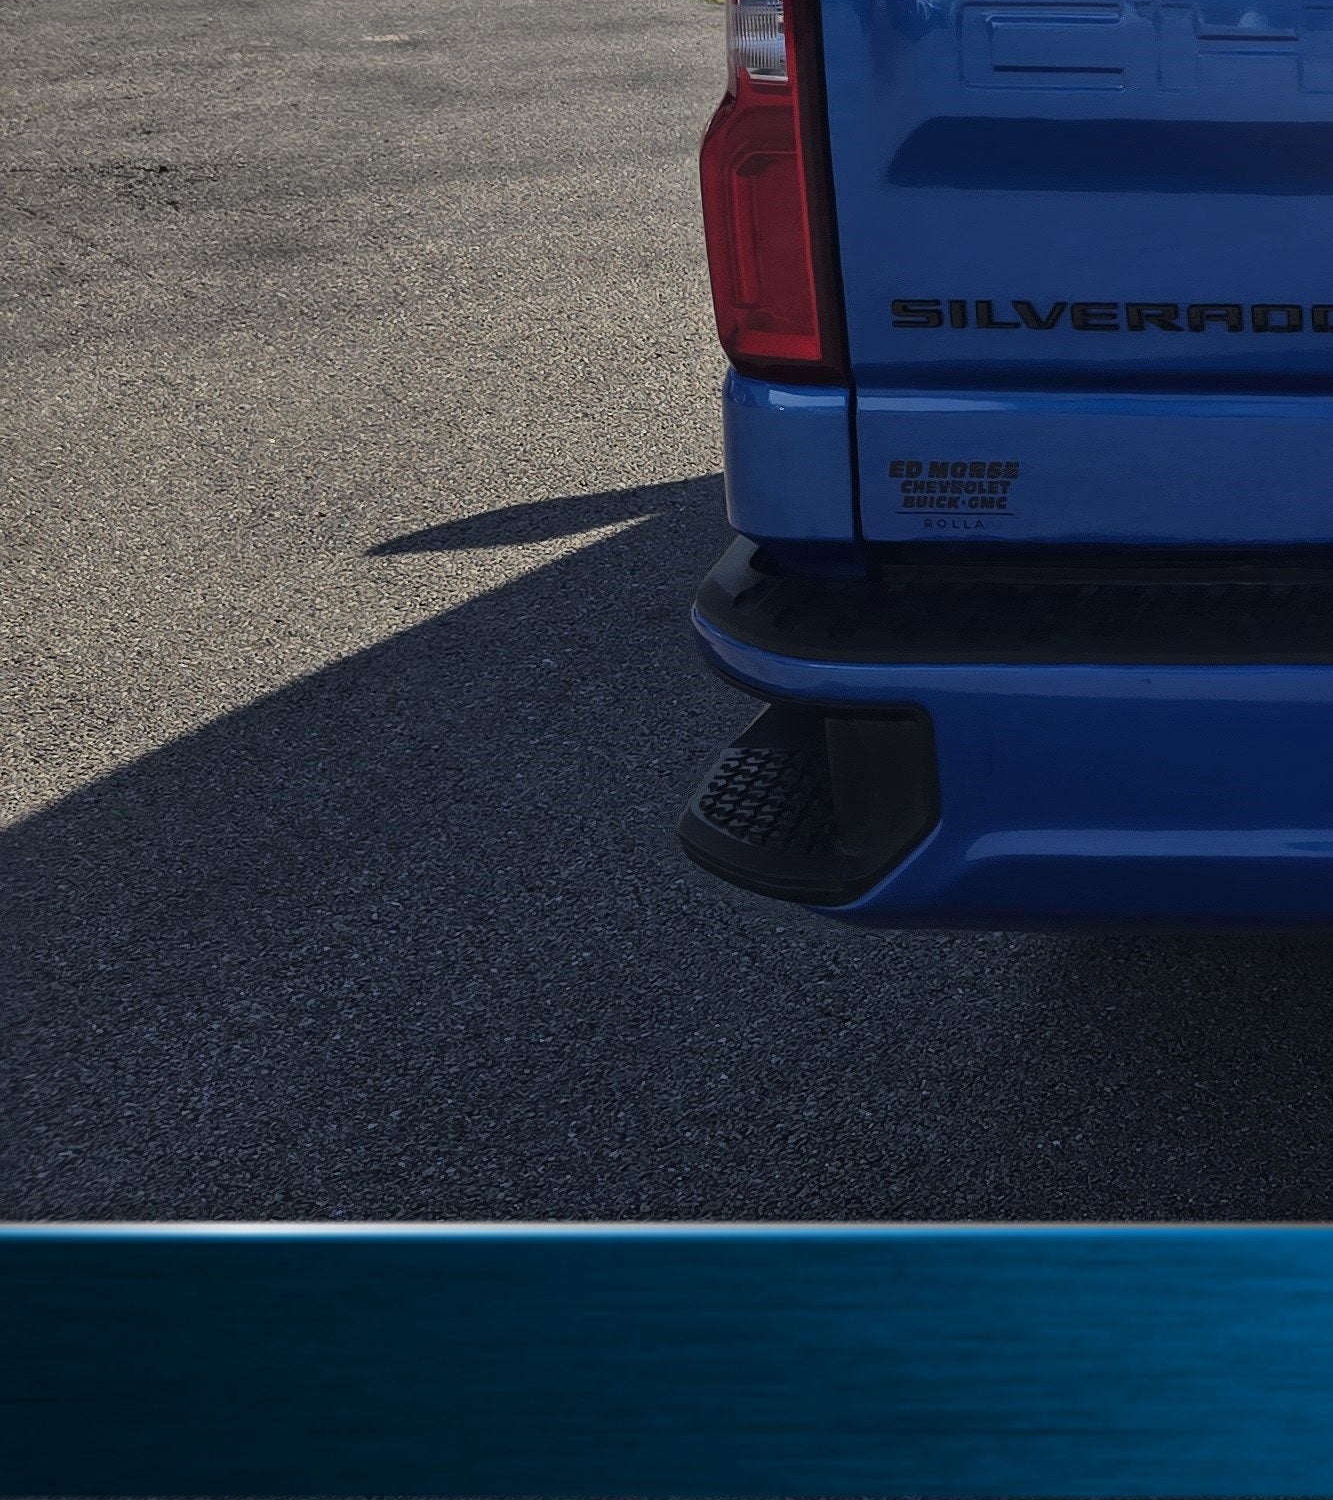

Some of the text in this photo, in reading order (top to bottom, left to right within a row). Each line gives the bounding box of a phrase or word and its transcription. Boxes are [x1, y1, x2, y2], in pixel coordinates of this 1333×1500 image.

[888, 460, 923, 479] ED
[901, 480, 1011, 495] CHEVROLET
[924, 518, 985, 530] ROLLA
